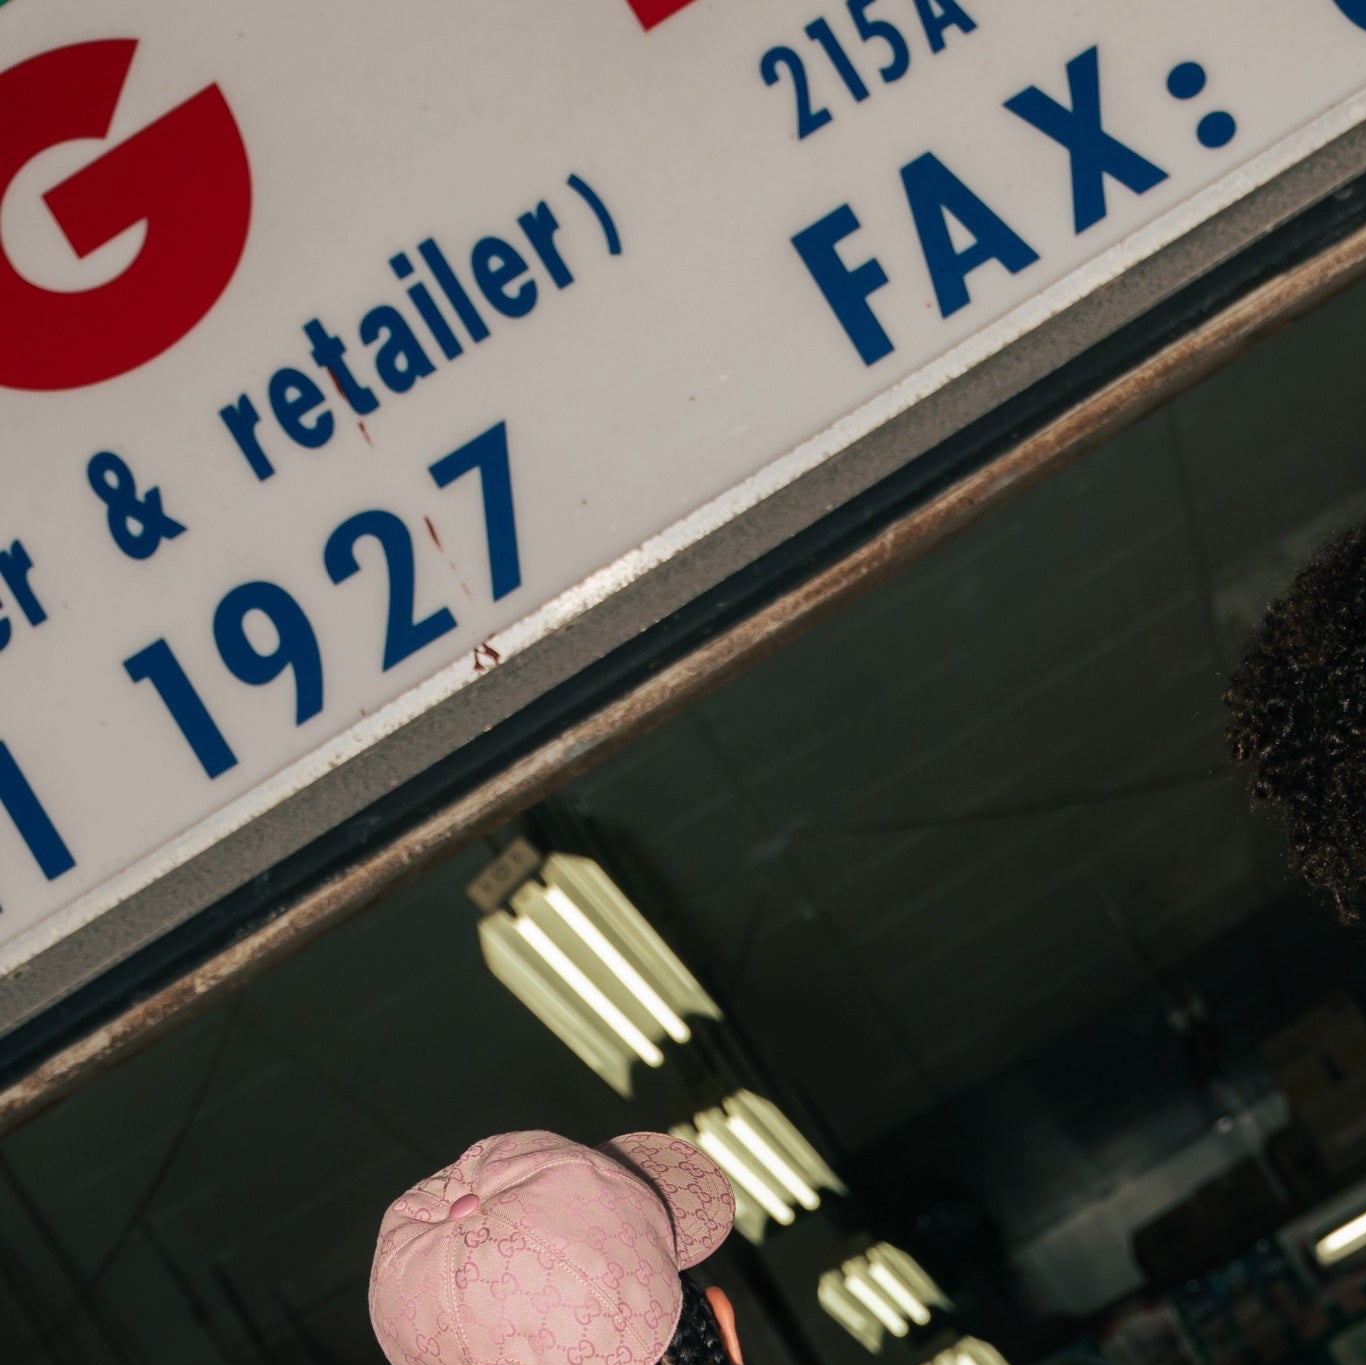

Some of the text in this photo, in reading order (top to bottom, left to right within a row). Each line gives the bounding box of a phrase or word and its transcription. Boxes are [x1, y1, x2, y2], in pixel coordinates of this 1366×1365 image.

[791, 45, 1236, 367] FAX:
[86, 451, 188, 561] &
[123, 420, 522, 781] 1927
